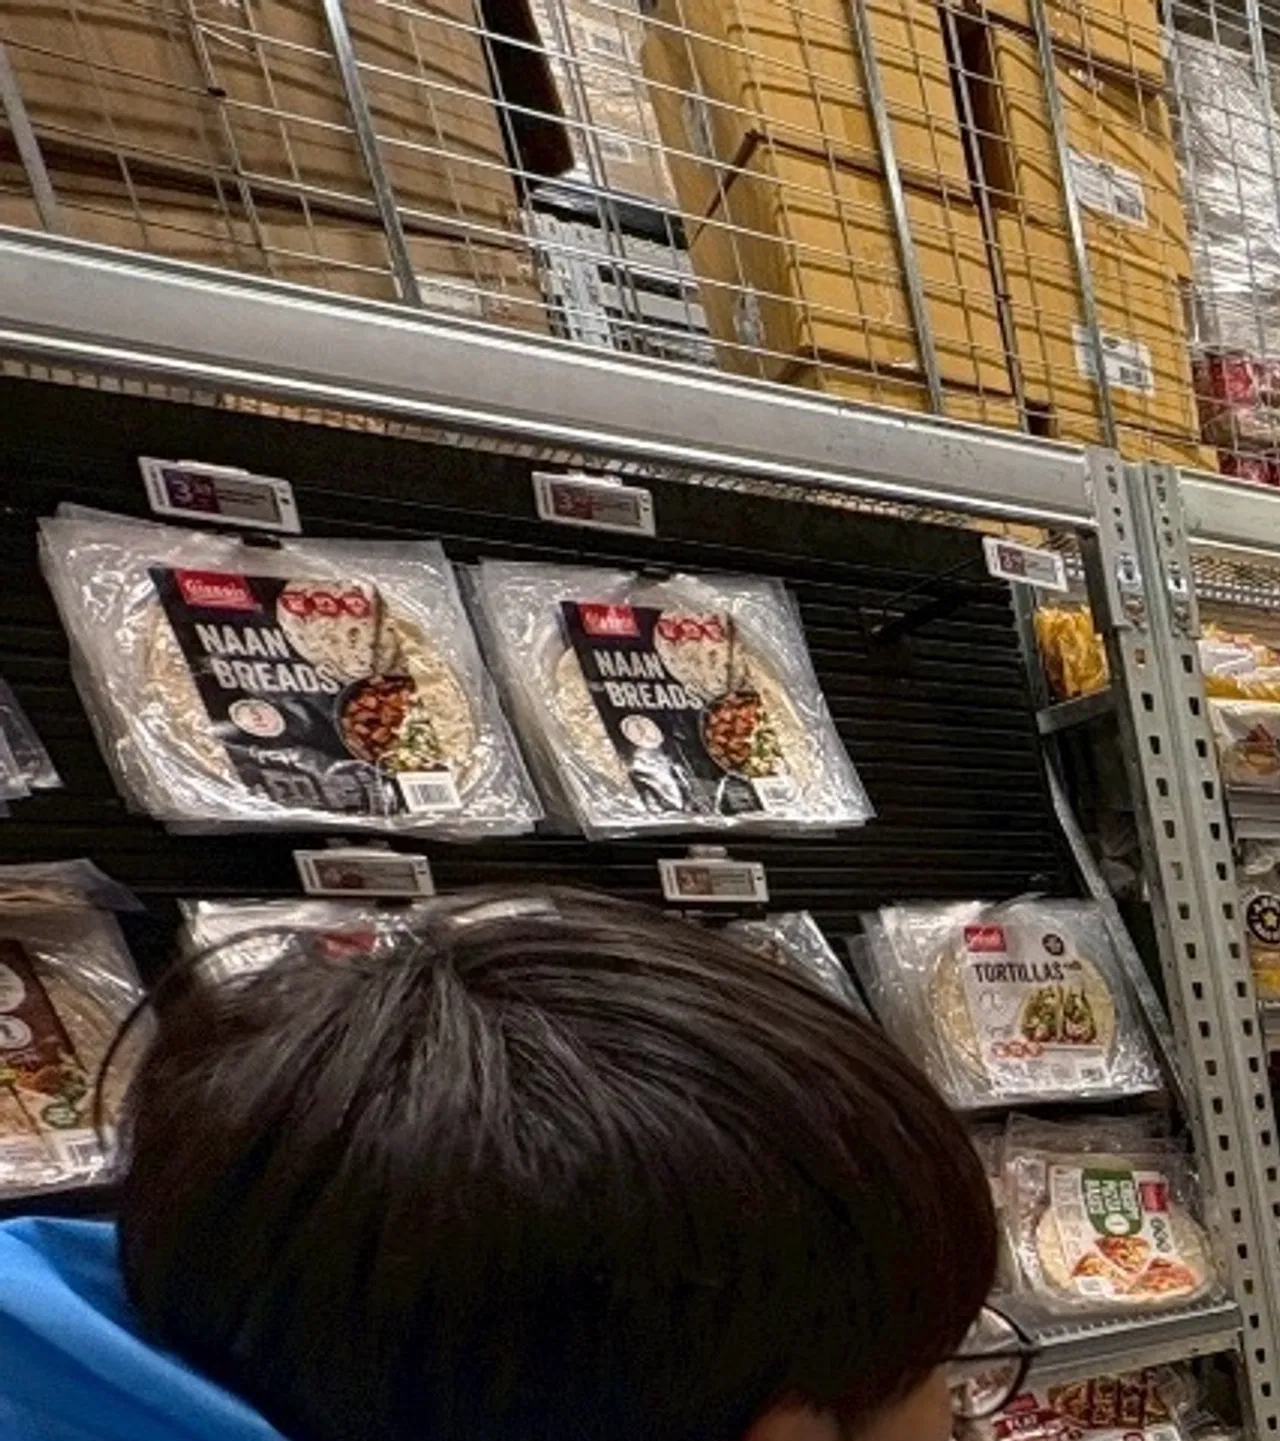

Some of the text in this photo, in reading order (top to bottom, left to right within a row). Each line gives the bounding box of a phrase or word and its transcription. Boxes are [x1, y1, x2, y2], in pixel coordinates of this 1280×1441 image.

[194, 624, 290, 658] NAAN
[210, 657, 340, 694] BREADS
[593, 651, 665, 680] NAAN
[604, 681, 703, 710] BREADS
[972, 961, 1065, 983] TORTILLAS
